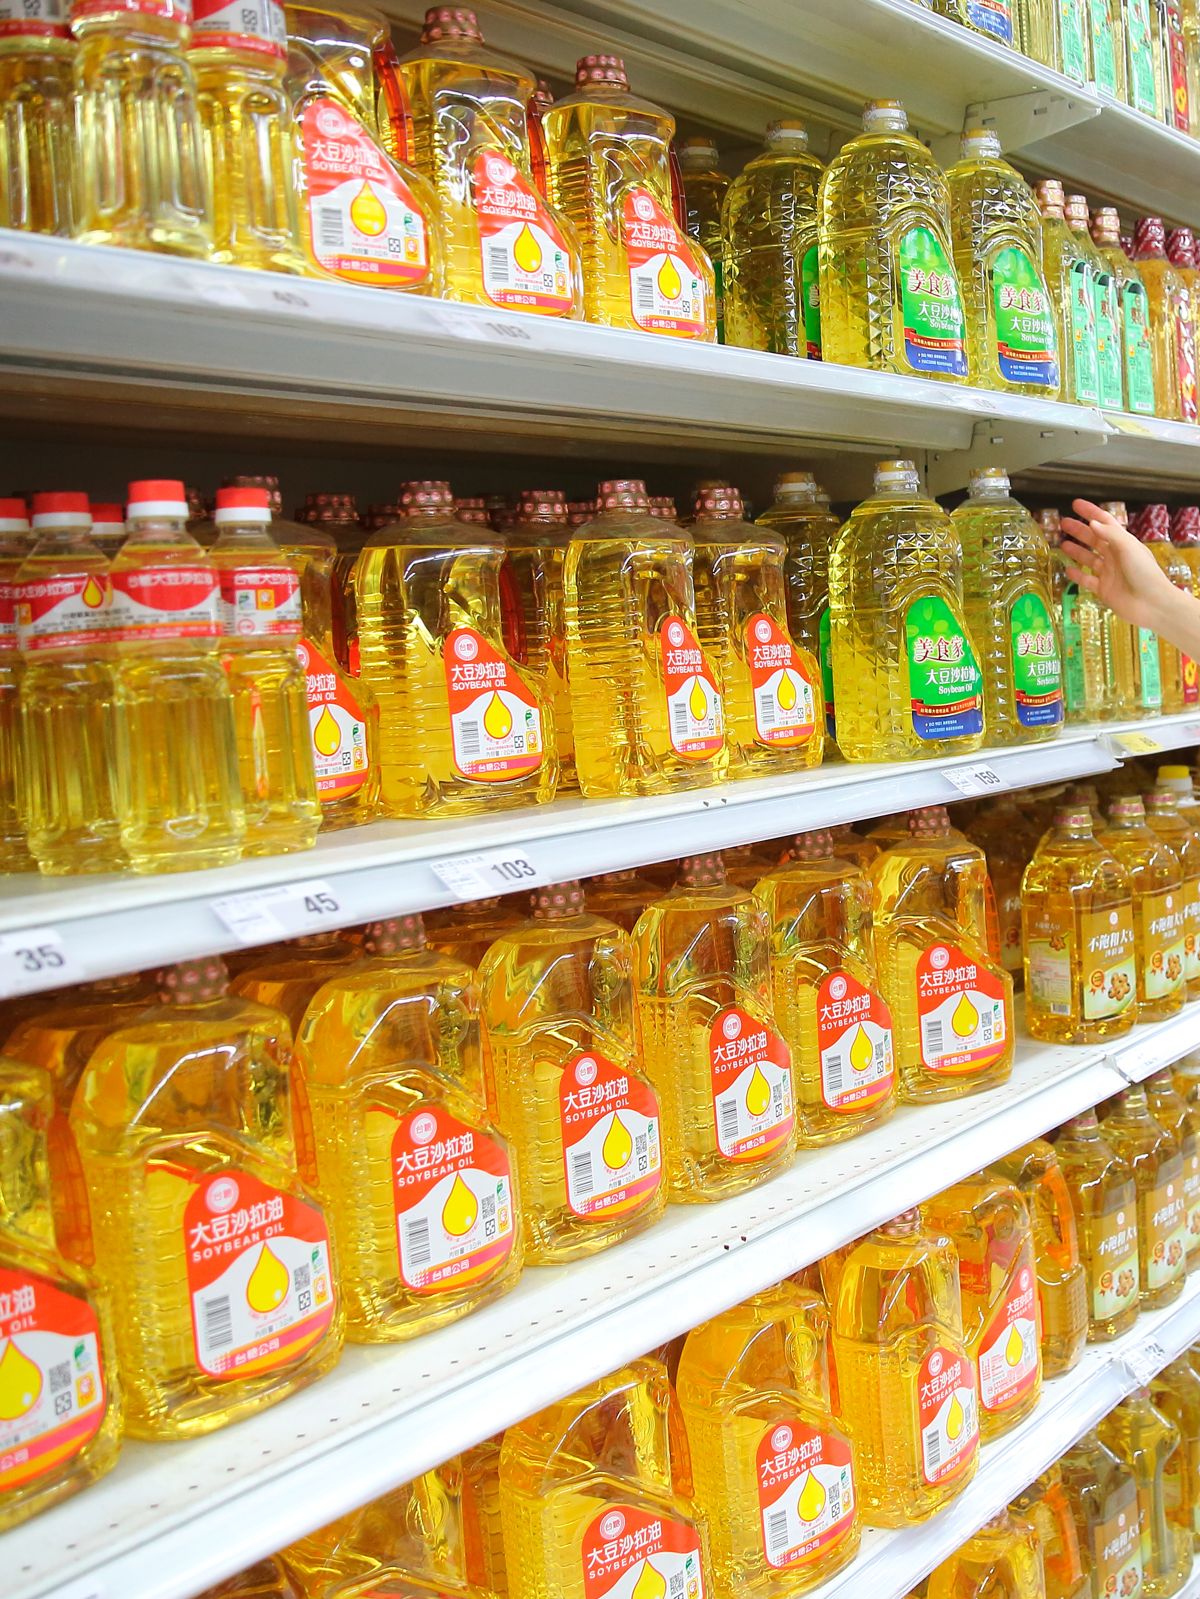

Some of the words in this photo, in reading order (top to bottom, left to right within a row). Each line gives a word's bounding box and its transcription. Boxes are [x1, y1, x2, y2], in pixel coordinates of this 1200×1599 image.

[312, 140, 380, 167] 大豆沙拉油
[312, 161, 362, 176] SOYBEAN
[366, 168, 388, 180] OIL
[482, 188, 536, 212] 大豆沙拉油
[482, 205, 524, 217] SOYBEAN
[526, 210, 537, 221] OIL
[631, 222, 678, 243] 大豆沙拉油
[631, 239, 666, 250] SOYBEAN
[667, 242, 677, 252] OIL
[908, 268, 957, 299] 美食家
[1000, 286, 1046, 315] 美食家
[753, 643, 792, 661] 大豆沙拉油
[914, 636, 964, 663] 美食家
[1017, 632, 1055, 657] 美食家
[667, 648, 702, 666] 大豆沙拉油
[754, 658, 782, 669] SOYBEAN
[784, 657, 792, 666] OIL
[451, 663, 507, 682] 大豆沙拉油
[667, 665, 694, 674] SOYBEAN
[695, 664, 703, 673] OIL
[926, 665, 977, 685] 大豆沙拉油
[452, 680, 492, 691] SOYBEAN
[495, 678, 507, 688] OIL
[938, 684, 965, 696] Soybean
[965, 683, 973, 692] Oil
[325, 692, 337, 701] OIL
[478, 761, 508, 772] 台糖公司
[974, 771, 1001, 785] 159
[491, 859, 536, 880] 103
[304, 892, 339, 915] 45
[15, 943, 65, 973] 35
[920, 965, 977, 989] 大豆沙拉油
[921, 985, 962, 997] SOYBEAN
[965, 981, 977, 990] OIL
[820, 994, 871, 1021] 大豆沙拉油
[821, 1015, 858, 1031] SOYBEAN
[860, 1011, 871, 1021] OIL
[713, 1031, 767, 1064] 大豆沙拉油
[714, 1057, 754, 1073] SOYBEAN
[756, 1051, 768, 1061] OIL
[563, 1076, 629, 1113] 大豆沙拉油
[565, 1104, 613, 1124] SOYBEAN
[615, 1098, 630, 1109] OIL
[396, 1131, 474, 1175] 大豆沙拉油
[739, 1136, 766, 1153] 台糖公司
[398, 1164, 454, 1187] SOYBEAN
[458, 1156, 475, 1171] OIL
[594, 1190, 626, 1210] 台糖公司
[190, 1196, 284, 1249] 大豆沙拉油
[193, 1232, 260, 1263] SOYBEAN
[265, 1222, 285, 1238] OIL
[432, 1258, 470, 1281] 台糖公司
[10, 1314, 38, 1332] OIL
[234, 1338, 280, 1366] 台糖公司
[921, 1360, 961, 1401] 大豆沙拉油
[922, 1388, 952, 1410] SOYBEAN
[761, 1435, 822, 1478] 大豆沙拉油
[762, 1464, 807, 1488] SOYBEAN
[810, 1456, 823, 1466] OIL
[587, 1520, 662, 1569] 大豆沙拉油
[790, 1539, 820, 1561] 台糖公司
[589, 1552, 642, 1579] SOYBEAN
[647, 1541, 663, 1554] OIL
